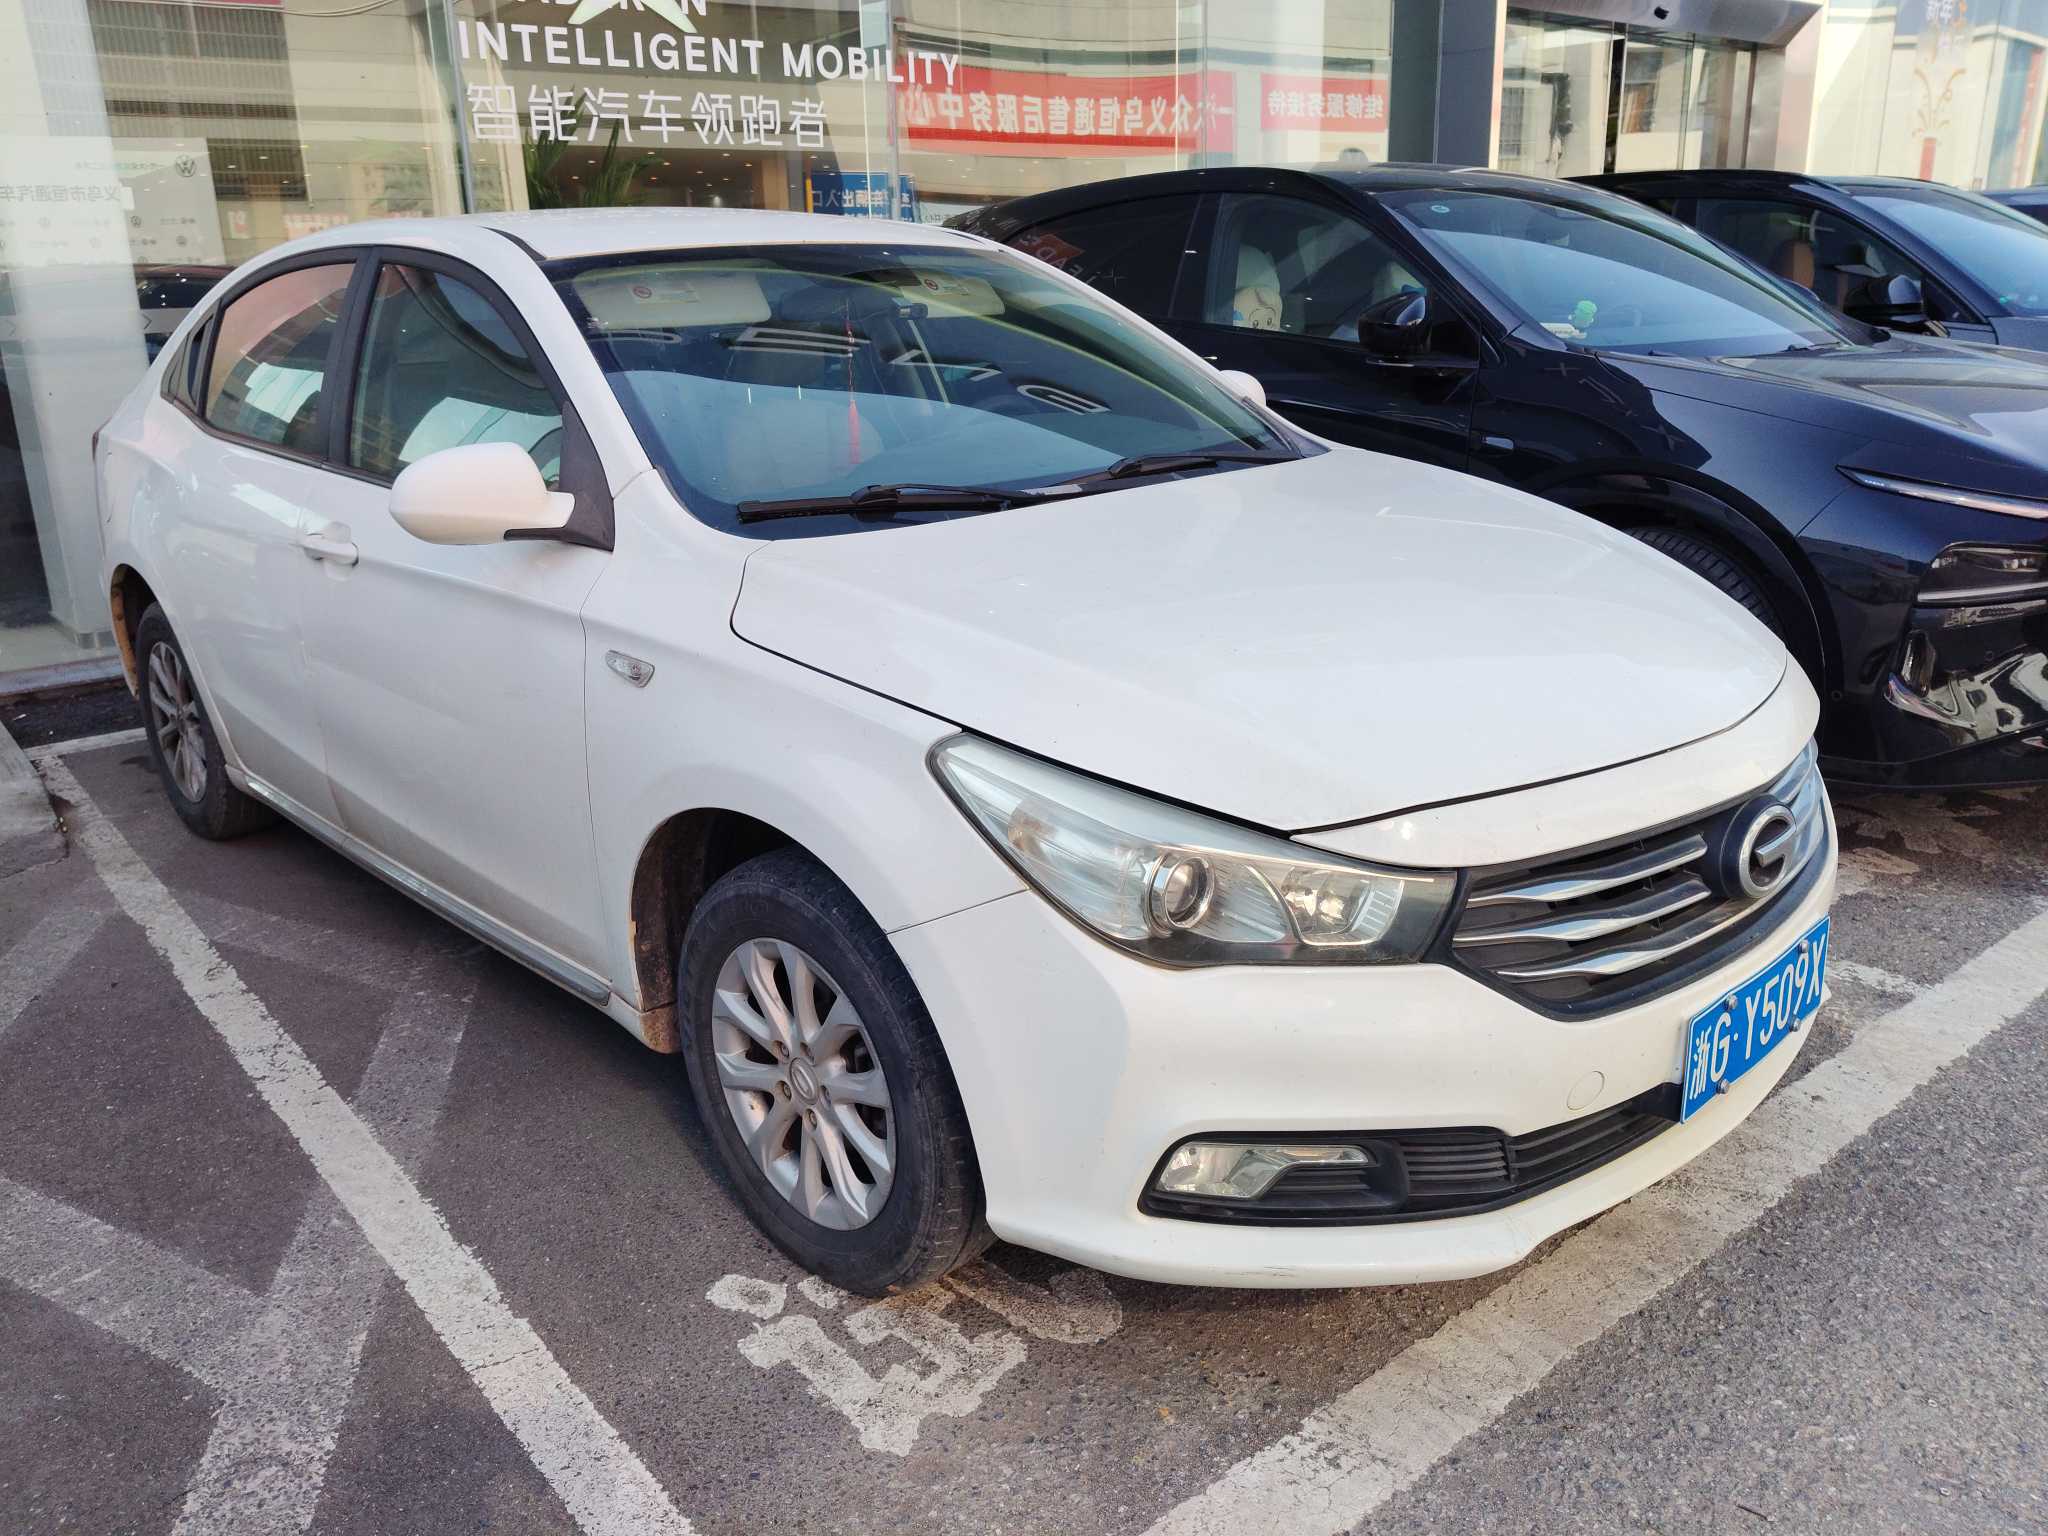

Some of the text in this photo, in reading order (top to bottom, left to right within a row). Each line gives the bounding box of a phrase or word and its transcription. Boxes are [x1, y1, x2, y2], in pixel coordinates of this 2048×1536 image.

[458, 20, 960, 87] INTELLIGENT MOBILITY
[466, 83, 827, 149] 智能汽车领跑者
